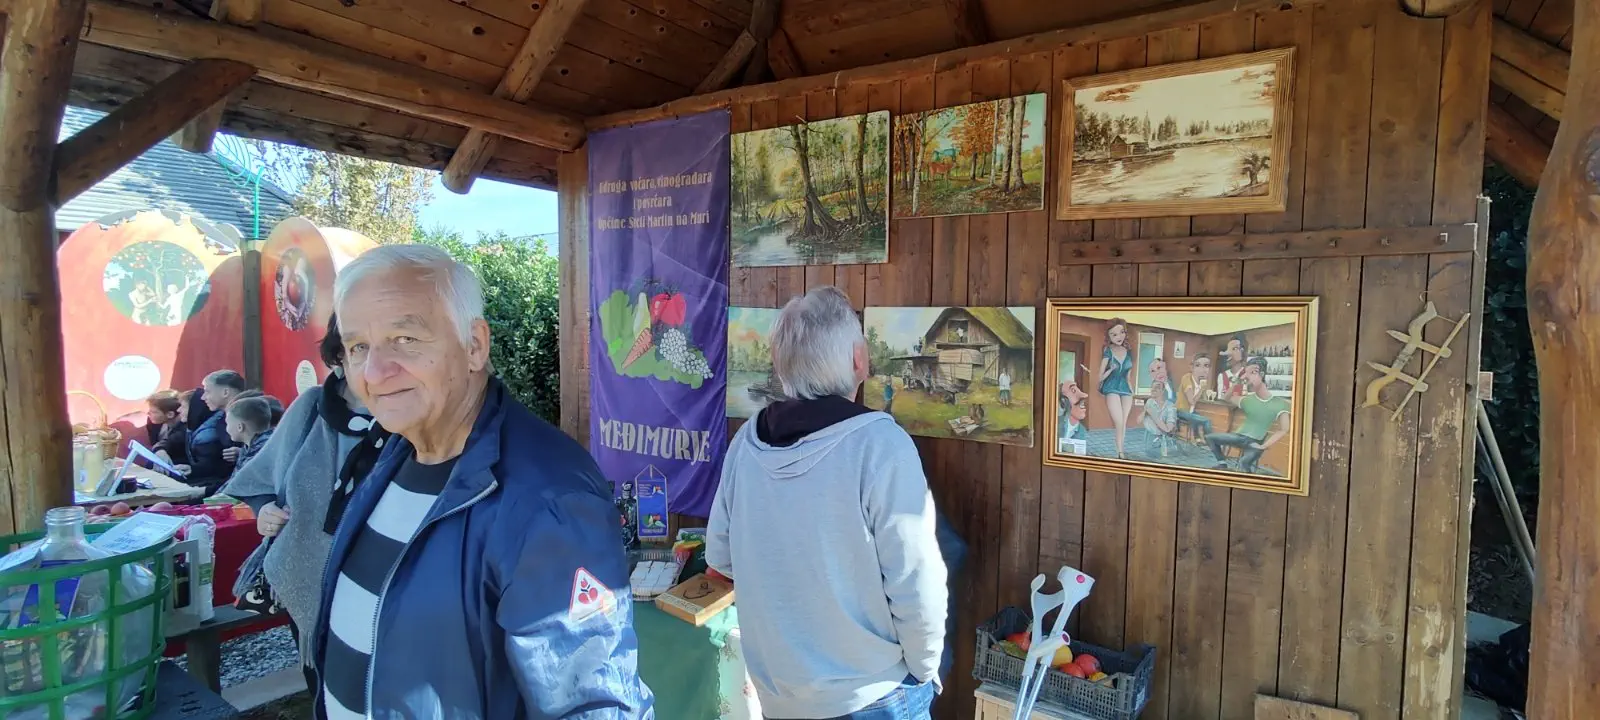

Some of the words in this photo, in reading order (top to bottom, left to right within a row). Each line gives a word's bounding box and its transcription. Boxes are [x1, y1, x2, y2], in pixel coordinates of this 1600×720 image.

[647, 213, 673, 228] Martin
[676, 215, 688, 225] na
[690, 210, 710, 225] Muri
[599, 417, 711, 466] MEĐIMURJE
